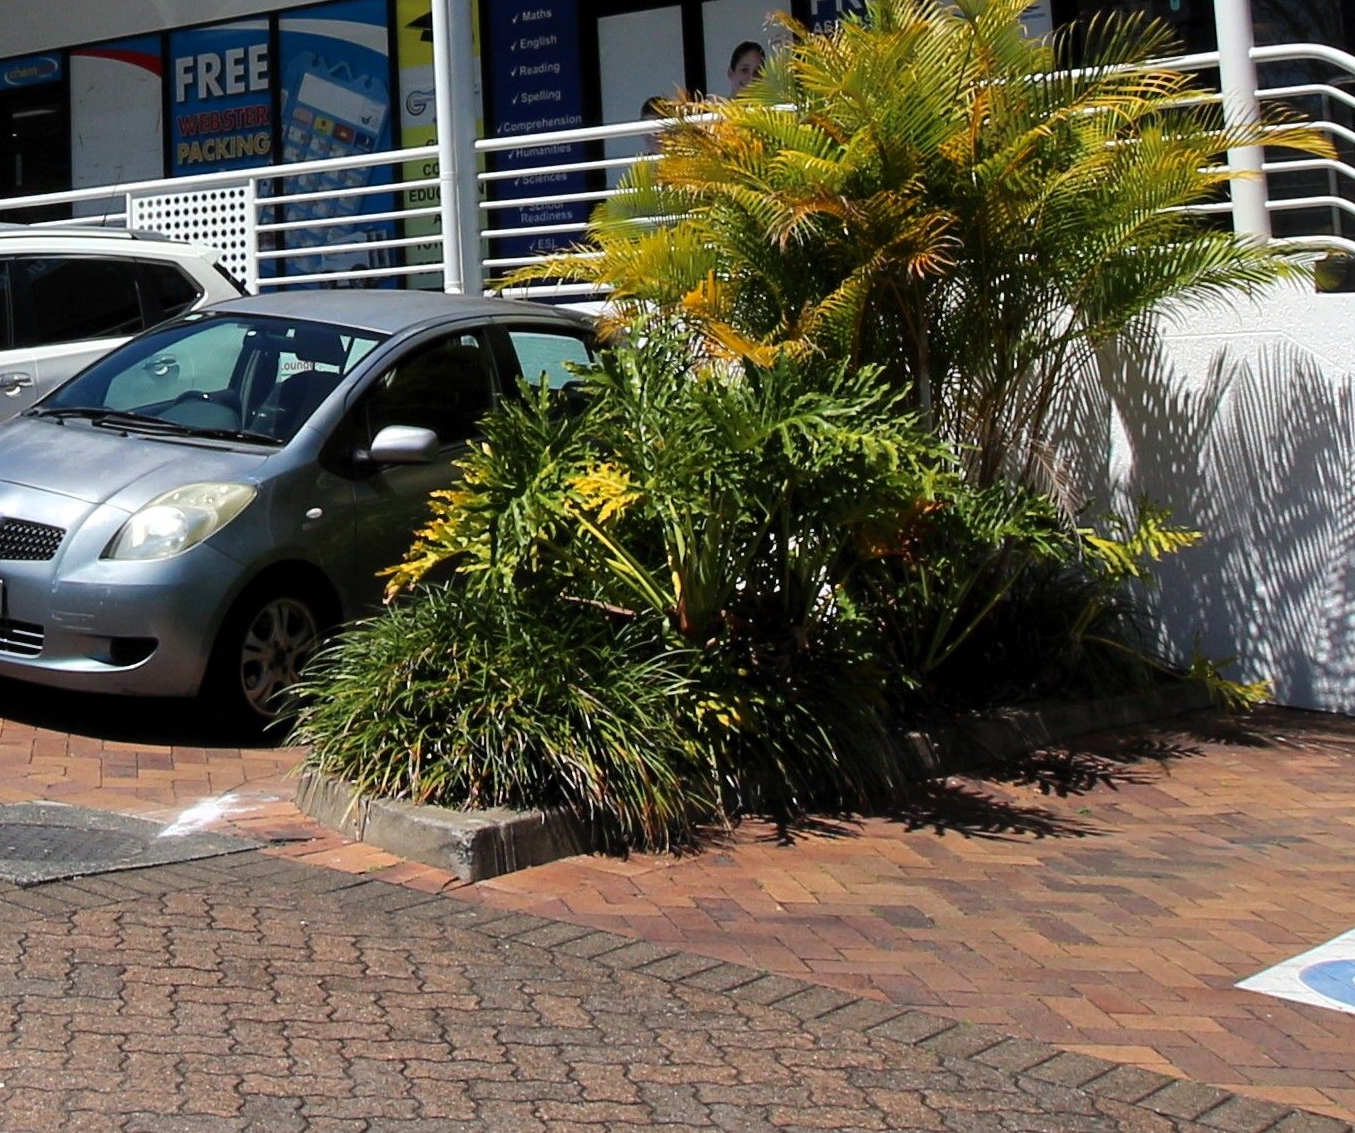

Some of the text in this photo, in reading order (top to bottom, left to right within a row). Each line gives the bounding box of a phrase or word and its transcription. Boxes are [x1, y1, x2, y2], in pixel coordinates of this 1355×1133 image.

[522, 8, 552, 22] Maths
[519, 35, 558, 50] English
[175, 43, 269, 103] FREE
[519, 62, 561, 76] Reading
[521, 89, 562, 104] Spelling
[177, 104, 270, 137] WEBSTER
[503, 114, 583, 133] Comprehension
[177, 131, 271, 165] PACKING
[515, 143, 572, 159] Humanities
[522, 171, 568, 186] Sciences
[520, 211, 574, 224] Readiness
